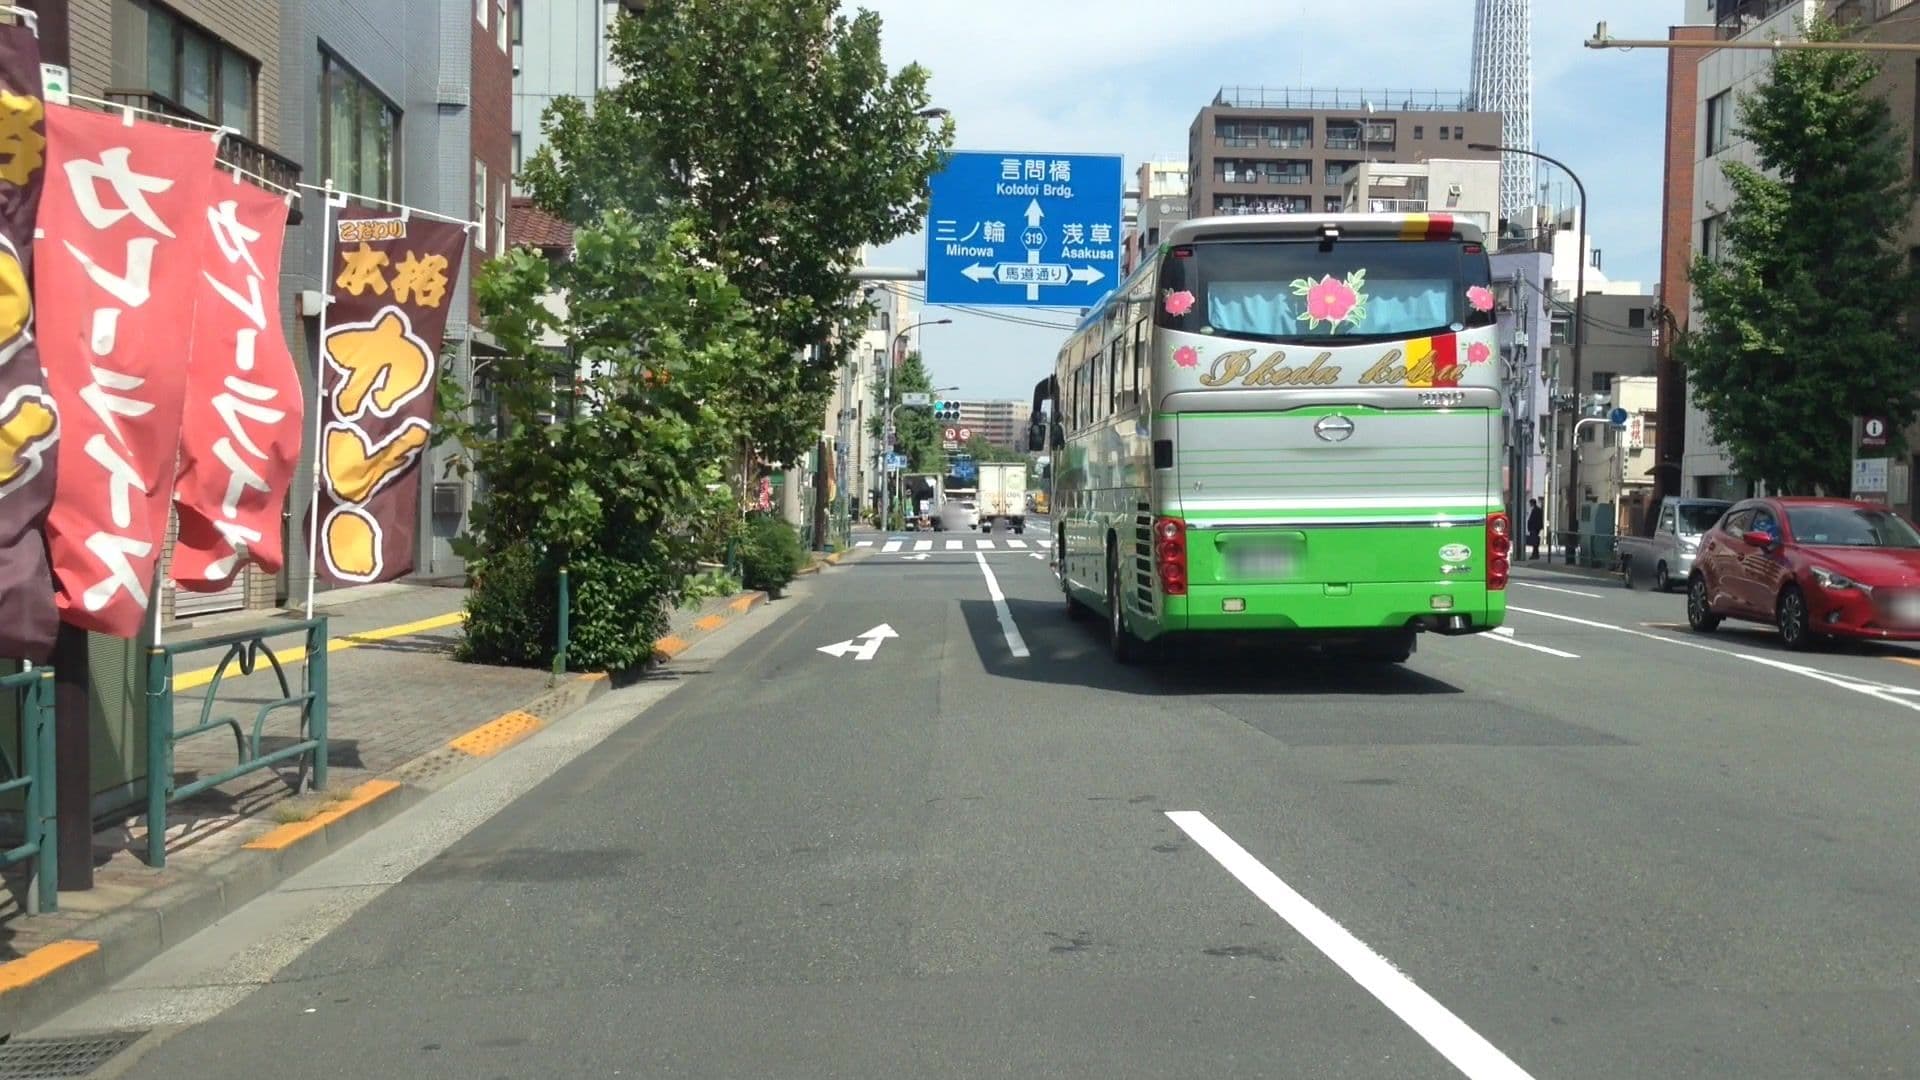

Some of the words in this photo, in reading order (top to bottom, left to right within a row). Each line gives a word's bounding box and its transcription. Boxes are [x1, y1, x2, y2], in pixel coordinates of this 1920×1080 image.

[1000, 158, 1071, 182] 言問橋
[996, 183, 1039, 196] Kototoi
[1043, 184, 1074, 198] Brdg.
[340, 220, 404, 241] こだわり
[935, 220, 1006, 243] 三ノ輪
[1025, 232, 1043, 245] 319
[1062, 223, 1112, 245] 浅草
[946, 243, 994, 257] Minowa
[1061, 245, 1114, 260] Asakusa
[336, 242, 448, 308] 本格
[1006, 266, 1062, 281] 馬道通り
[1199, 348, 1342, 387] Ikeda
[1418, 392, 1465, 401] HINO
[322, 305, 435, 583] カレー
